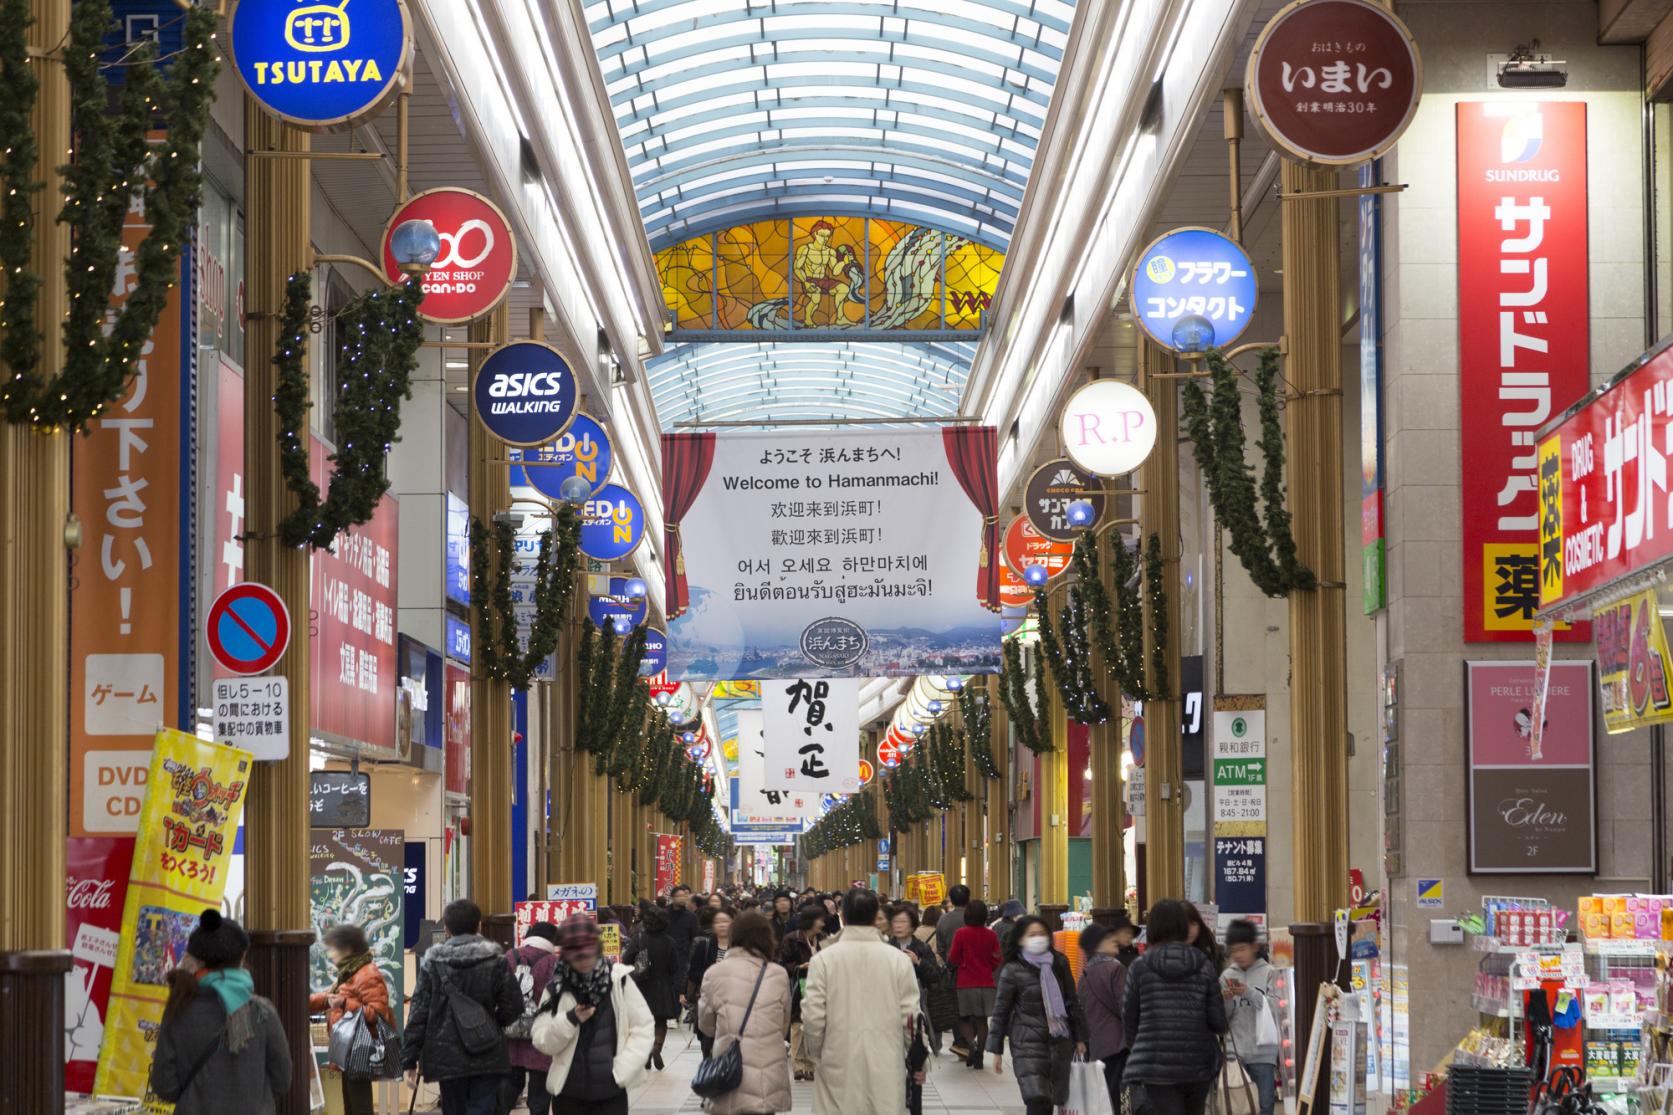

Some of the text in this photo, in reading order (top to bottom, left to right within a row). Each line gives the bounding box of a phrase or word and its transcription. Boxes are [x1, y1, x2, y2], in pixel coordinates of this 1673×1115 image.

[1311, 41, 1366, 53] おはきもの
[254, 59, 382, 85] TSUTAYA
[1281, 60, 1393, 94] いまい
[1295, 101, 1377, 114] 創業明治30年
[1485, 169, 1559, 182] SUNDRUG
[453, 271, 485, 281] SHOP
[1178, 261, 1247, 284] フラワー
[1147, 296, 1245, 321] コンタクト
[488, 372, 562, 398] asics
[490, 400, 562, 415] WALKING
[1073, 410, 1145, 446] R.P
[759, 447, 901, 464] ようこそ 浜んまちへ!
[1571, 431, 1594, 482] DRUG
[723, 471, 939, 491] Welcome to Hamanmachi!
[770, 501, 882, 518] 欢迎来到浜町!
[1580, 484, 1588, 524] &
[770, 528, 883, 546] 歡迎來到浜町!
[1565, 521, 1604, 577] COSMETIC
[737, 554, 929, 576] 어서 오세요 하만마치에
[808, 635, 861, 651] 浜んまち
[91, 684, 158, 706] ゲーム
[1490, 686, 1522, 696] PERLE
[218, 701, 283, 718] の間における
[785, 678, 834, 779] 賀正
[1219, 742, 1260, 754] 親和銀行
[98, 766, 149, 786] DVD
[1217, 765, 1247, 779] ATM
[310, 782, 368, 795] いコーヒーを
[106, 797, 142, 816] CD
[1498, 798, 1568, 826] Eden
[1216, 840, 1263, 855] テナント募集
[160, 852, 216, 884] をつくろう!
[552, 886, 593, 898] メガネの
